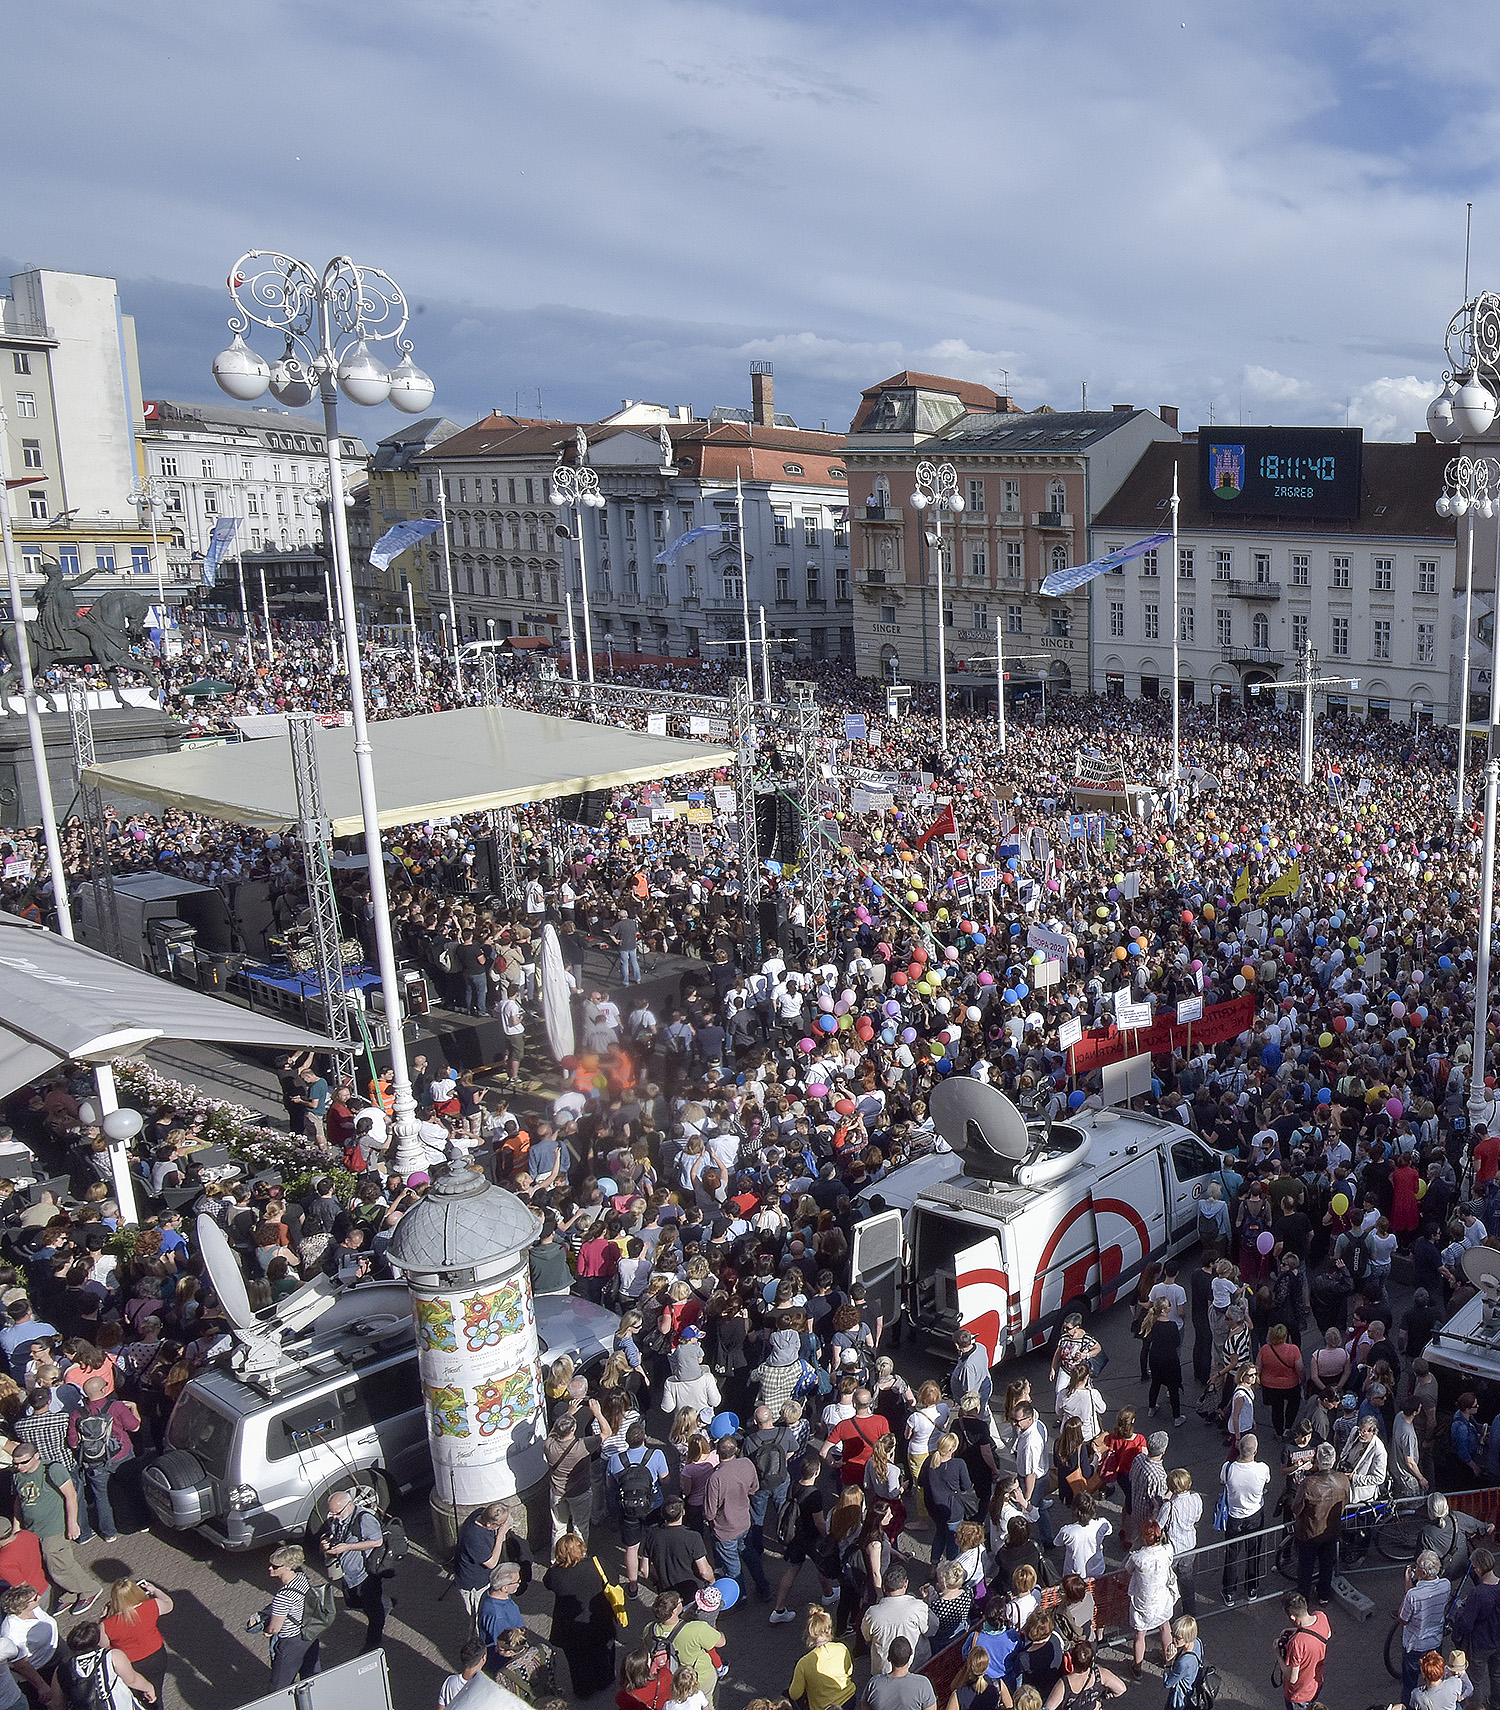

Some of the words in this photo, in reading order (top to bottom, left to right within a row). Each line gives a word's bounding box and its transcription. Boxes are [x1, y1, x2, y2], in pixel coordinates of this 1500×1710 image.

[1274, 486, 1314, 499] ZAGREB
[872, 623, 901, 635] SINGER
[1040, 637, 1075, 650] SINGER
